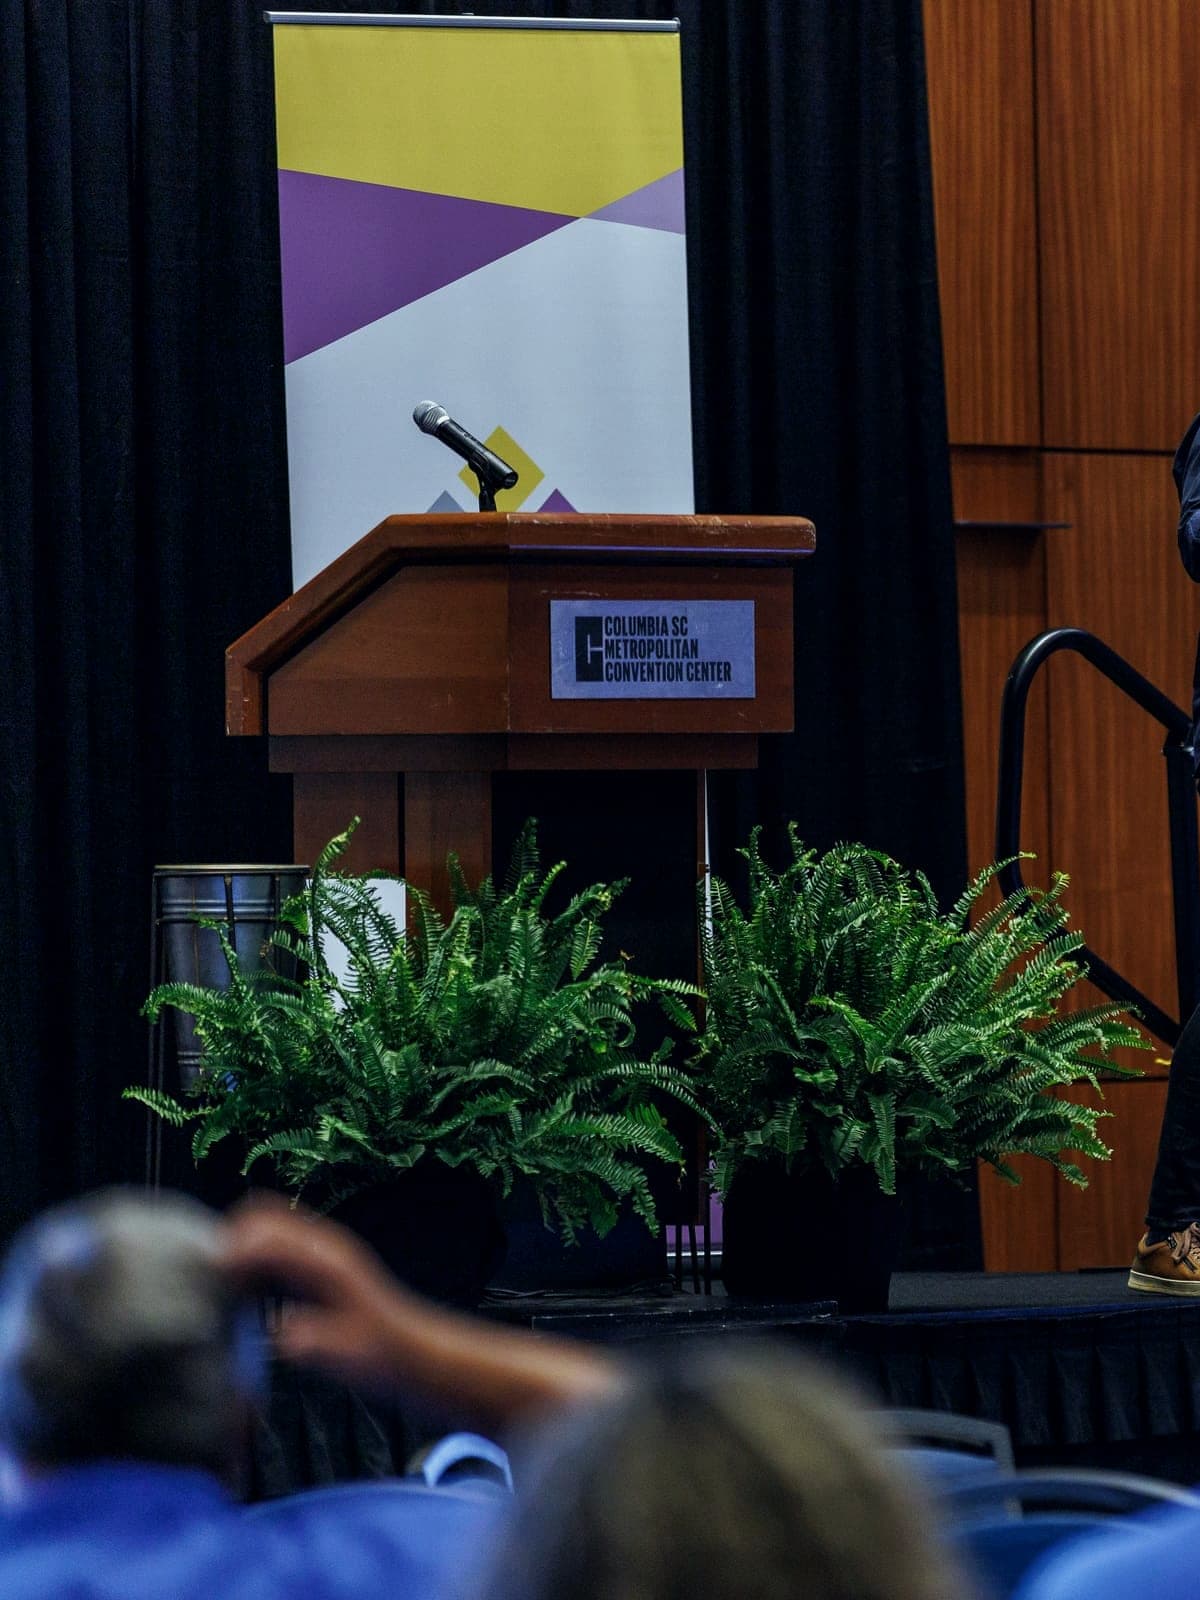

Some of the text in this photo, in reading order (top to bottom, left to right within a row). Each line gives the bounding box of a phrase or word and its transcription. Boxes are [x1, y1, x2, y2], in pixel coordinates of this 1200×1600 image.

[604, 616, 688, 636] COLUMBIA SC
[605, 639, 698, 659] METROPOLITAN
[605, 661, 732, 682] CONVENTION CENTER
